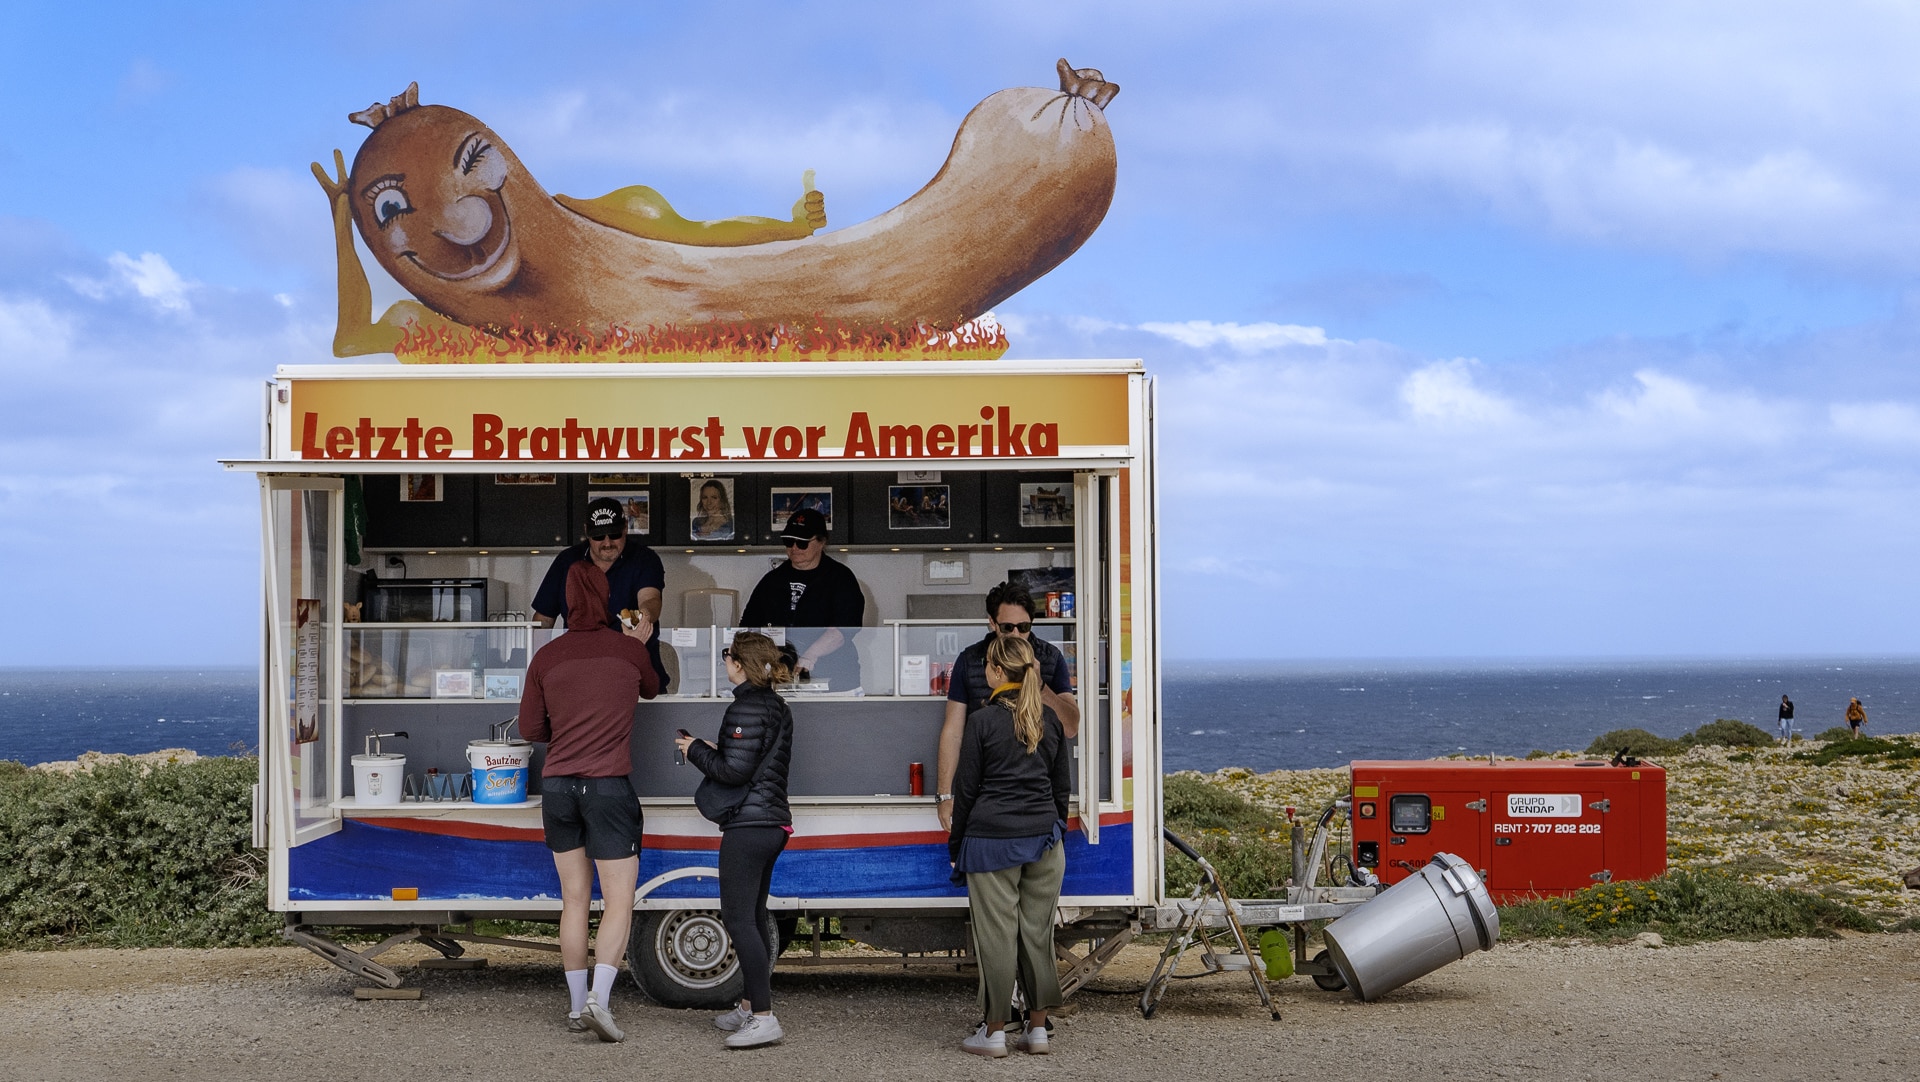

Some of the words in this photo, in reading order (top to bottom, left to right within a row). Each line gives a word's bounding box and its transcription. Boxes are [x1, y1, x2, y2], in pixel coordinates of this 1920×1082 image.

[301, 411, 453, 460] Letzte
[472, 412, 724, 459] Bratwurst
[742, 424, 826, 458] vor
[843, 405, 1059, 457] Amerika
[590, 508, 617, 521] LONSDALE
[594, 518, 613, 526] LONDON
[485, 770, 520, 790] Senf
[1510, 797, 1546, 806] GRUPO
[1511, 805, 1555, 814] VENDAP
[1494, 823, 1523, 833] RENT
[1531, 823, 1553, 833] 707
[1555, 823, 1577, 834] 202
[1579, 823, 1601, 834] 202
